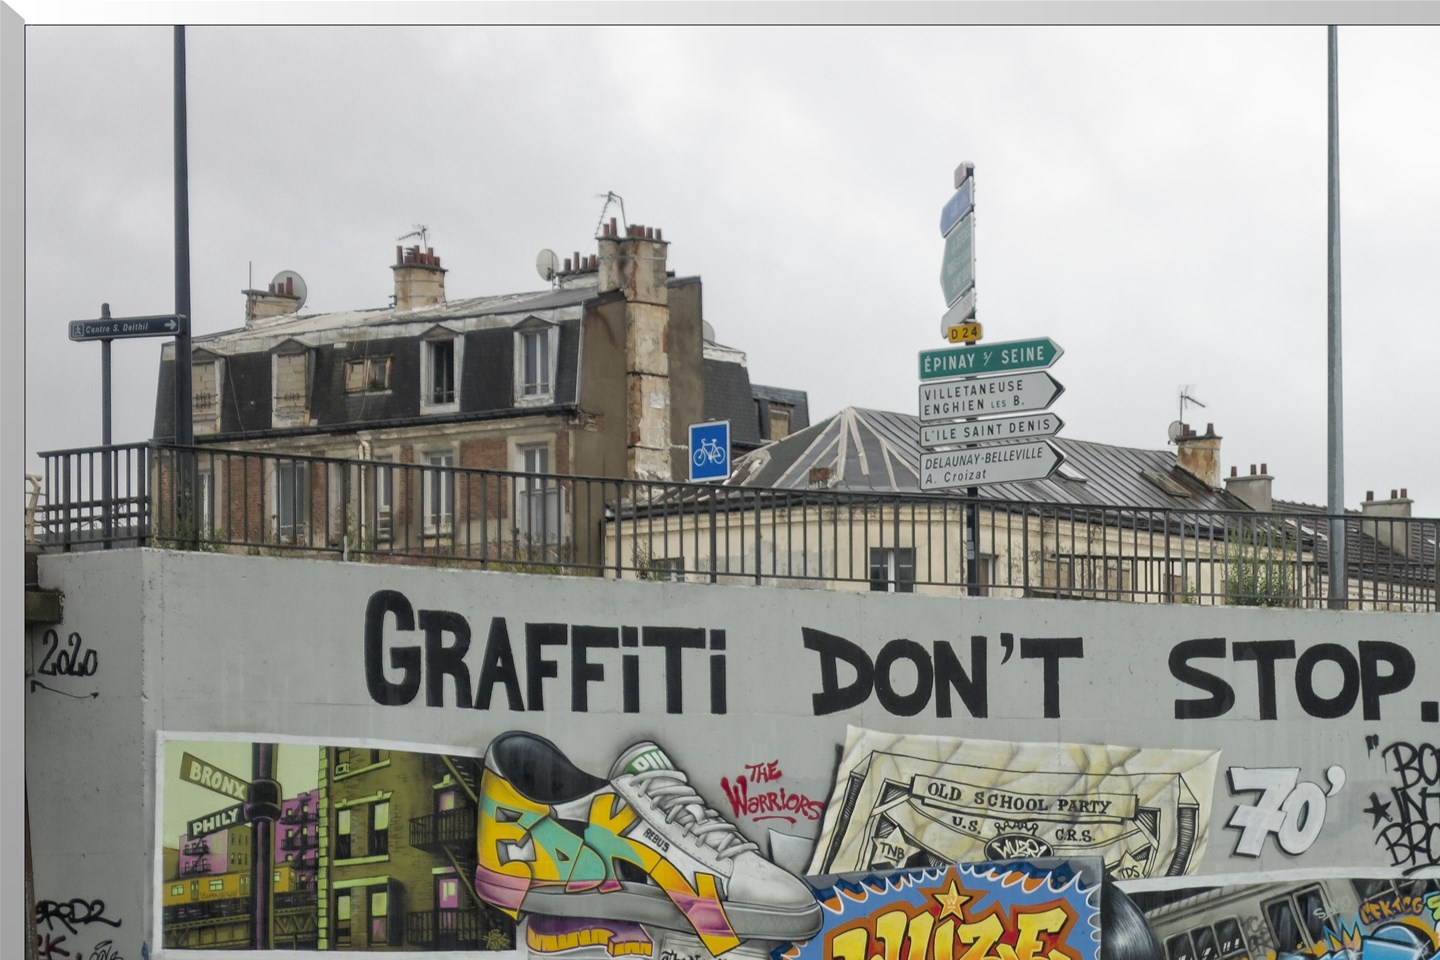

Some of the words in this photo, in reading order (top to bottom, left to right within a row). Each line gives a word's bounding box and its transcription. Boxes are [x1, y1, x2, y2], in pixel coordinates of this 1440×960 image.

[86, 326, 110, 334] Centre
[113, 324, 120, 332] S.
[952, 330, 958, 339] D
[962, 326, 978, 338] 24
[924, 353, 975, 372] ÉPINAY
[1001, 346, 1045, 364] SEINE
[925, 380, 1024, 400] VILLETANEUSE
[925, 399, 984, 415] ENGHIEN
[991, 399, 1006, 408] LES
[1013, 396, 1025, 406] B.
[925, 428, 957, 441] L'ILE
[964, 424, 1002, 438] SAINT
[1009, 419, 1050, 433] DENIS
[925, 447, 1043, 469] DELAUNAY-BELLEVILLE
[925, 473, 936, 484] A.
[944, 469, 987, 483] Croizat
[38, 629, 98, 677] 2020
[800, 625, 1084, 719] DON'T
[189, 760, 247, 801] BRONX
[744, 759, 782, 784] THE
[927, 782, 962, 801] OLD
[974, 791, 1049, 811] SCHOOL
[1057, 798, 1112, 814] PARTY
[192, 807, 240, 836] PHILY
[951, 816, 981, 834] U.S.
[1055, 827, 1096, 842] C.R.S.
[643, 828, 670, 851] REBUS
[879, 842, 905, 860] TNB
[1118, 864, 1140, 878] TDS
